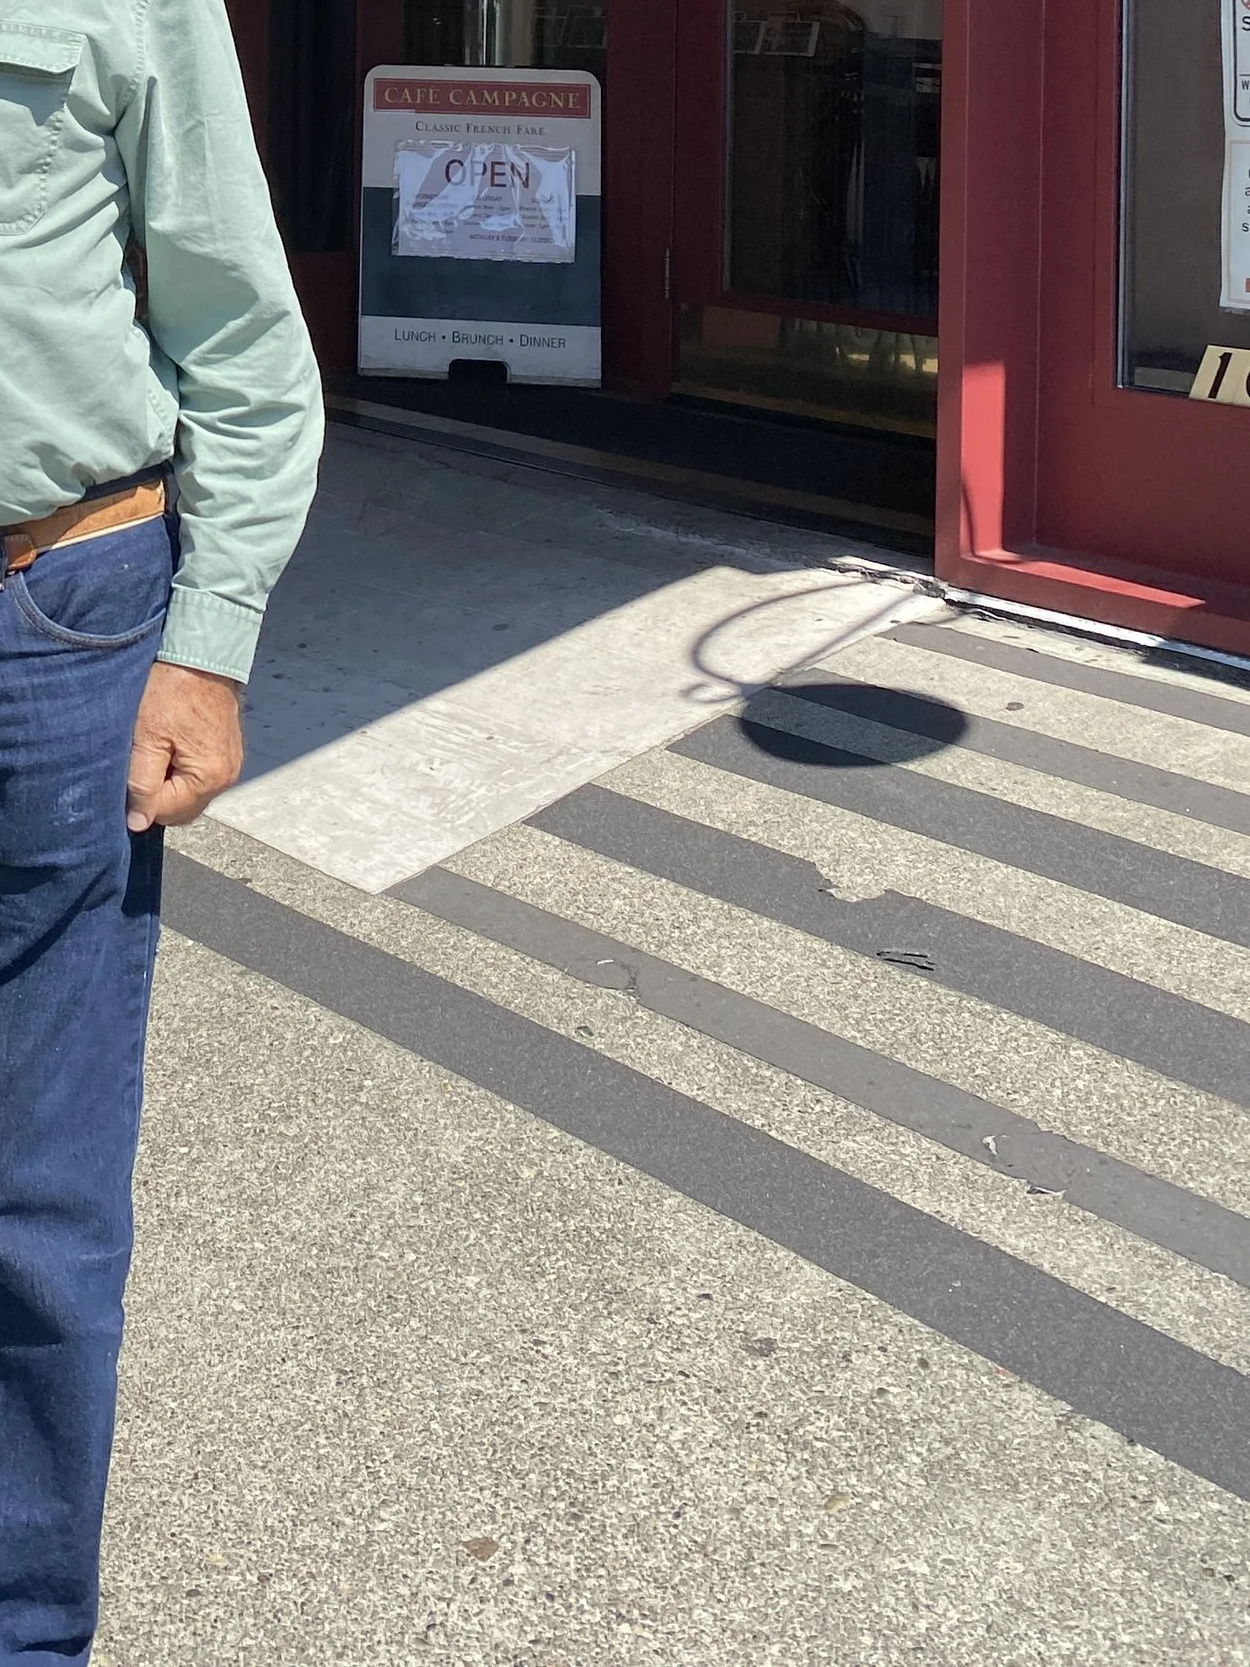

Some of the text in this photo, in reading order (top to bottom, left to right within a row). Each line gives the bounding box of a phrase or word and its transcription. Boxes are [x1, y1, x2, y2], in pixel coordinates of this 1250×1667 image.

[384, 86, 581, 109] CAFÉ CAMPAGNE
[445, 159, 530, 188] OPEN
[394, 328, 567, 348] LUNCH BRUNCH DINNER
